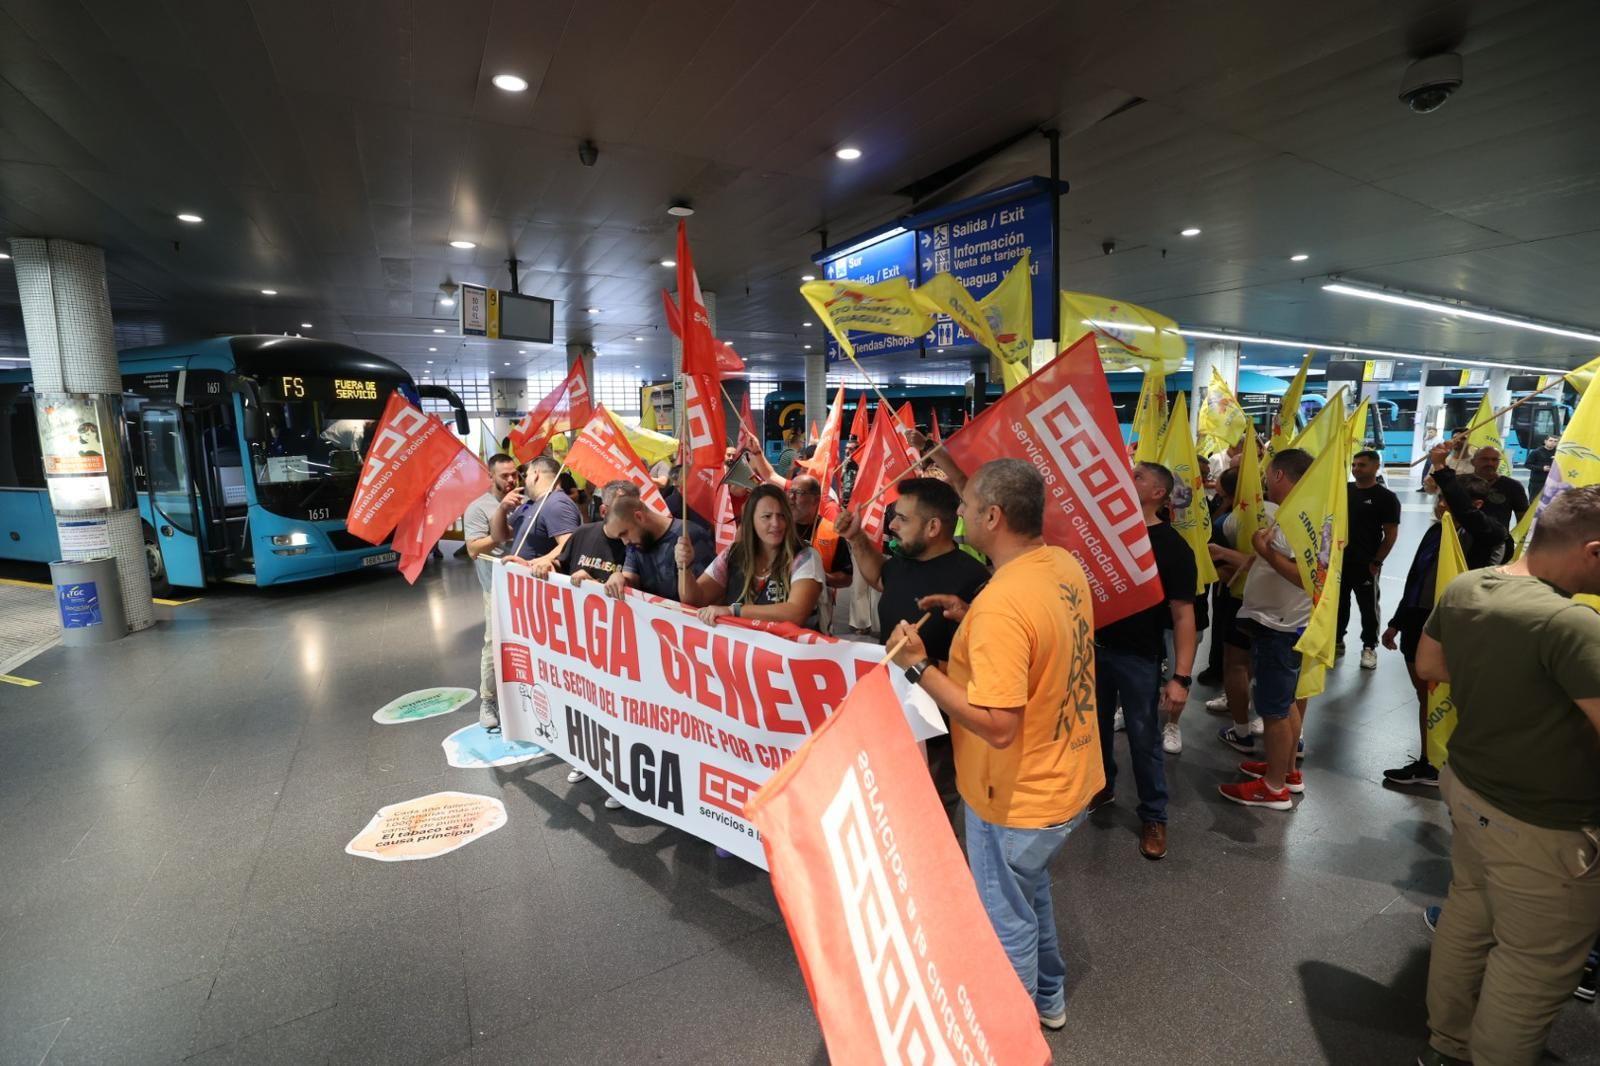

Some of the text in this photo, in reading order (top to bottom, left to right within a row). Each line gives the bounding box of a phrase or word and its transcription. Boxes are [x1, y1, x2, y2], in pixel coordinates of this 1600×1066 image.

[952, 206, 1025, 238] Salida / Exit
[953, 231, 1025, 259] Información
[847, 257, 863, 269] Sur
[953, 257, 978, 270] Venta
[980, 253, 992, 265] de
[882, 264, 900, 279] Exit
[955, 271, 998, 288] Guagua
[852, 336, 915, 353] Tiendas/Shops
[207, 382, 220, 393] 1651
[282, 376, 305, 397] FS
[334, 379, 377, 391] FUERA DE
[335, 389, 377, 400] SERVICIO
[308, 507, 330, 521] 1651
[1010, 421, 1057, 486] servicios
[1051, 484, 1065, 499] a
[1058, 494, 1076, 515] la
[1071, 515, 1129, 595] ciudadanía
[506, 571, 642, 683] HUELGA
[537, 658, 549, 683] EN
[549, 664, 562, 689] EL
[562, 671, 599, 700] SECTOR
[599, 686, 618, 719] DEL
[620, 696, 719, 749] TRANSPORTE
[718, 728, 754, 763] POR
[755, 743, 797, 771] CAR
[565, 705, 685, 817] HUELGA
[382, 832, 394, 840] El
[398, 826, 442, 838] tabaco
[462, 821, 475, 829] la
[699, 805, 746, 834] servicios
[747, 827, 755, 838] a
[375, 827, 476, 848] causa principal
